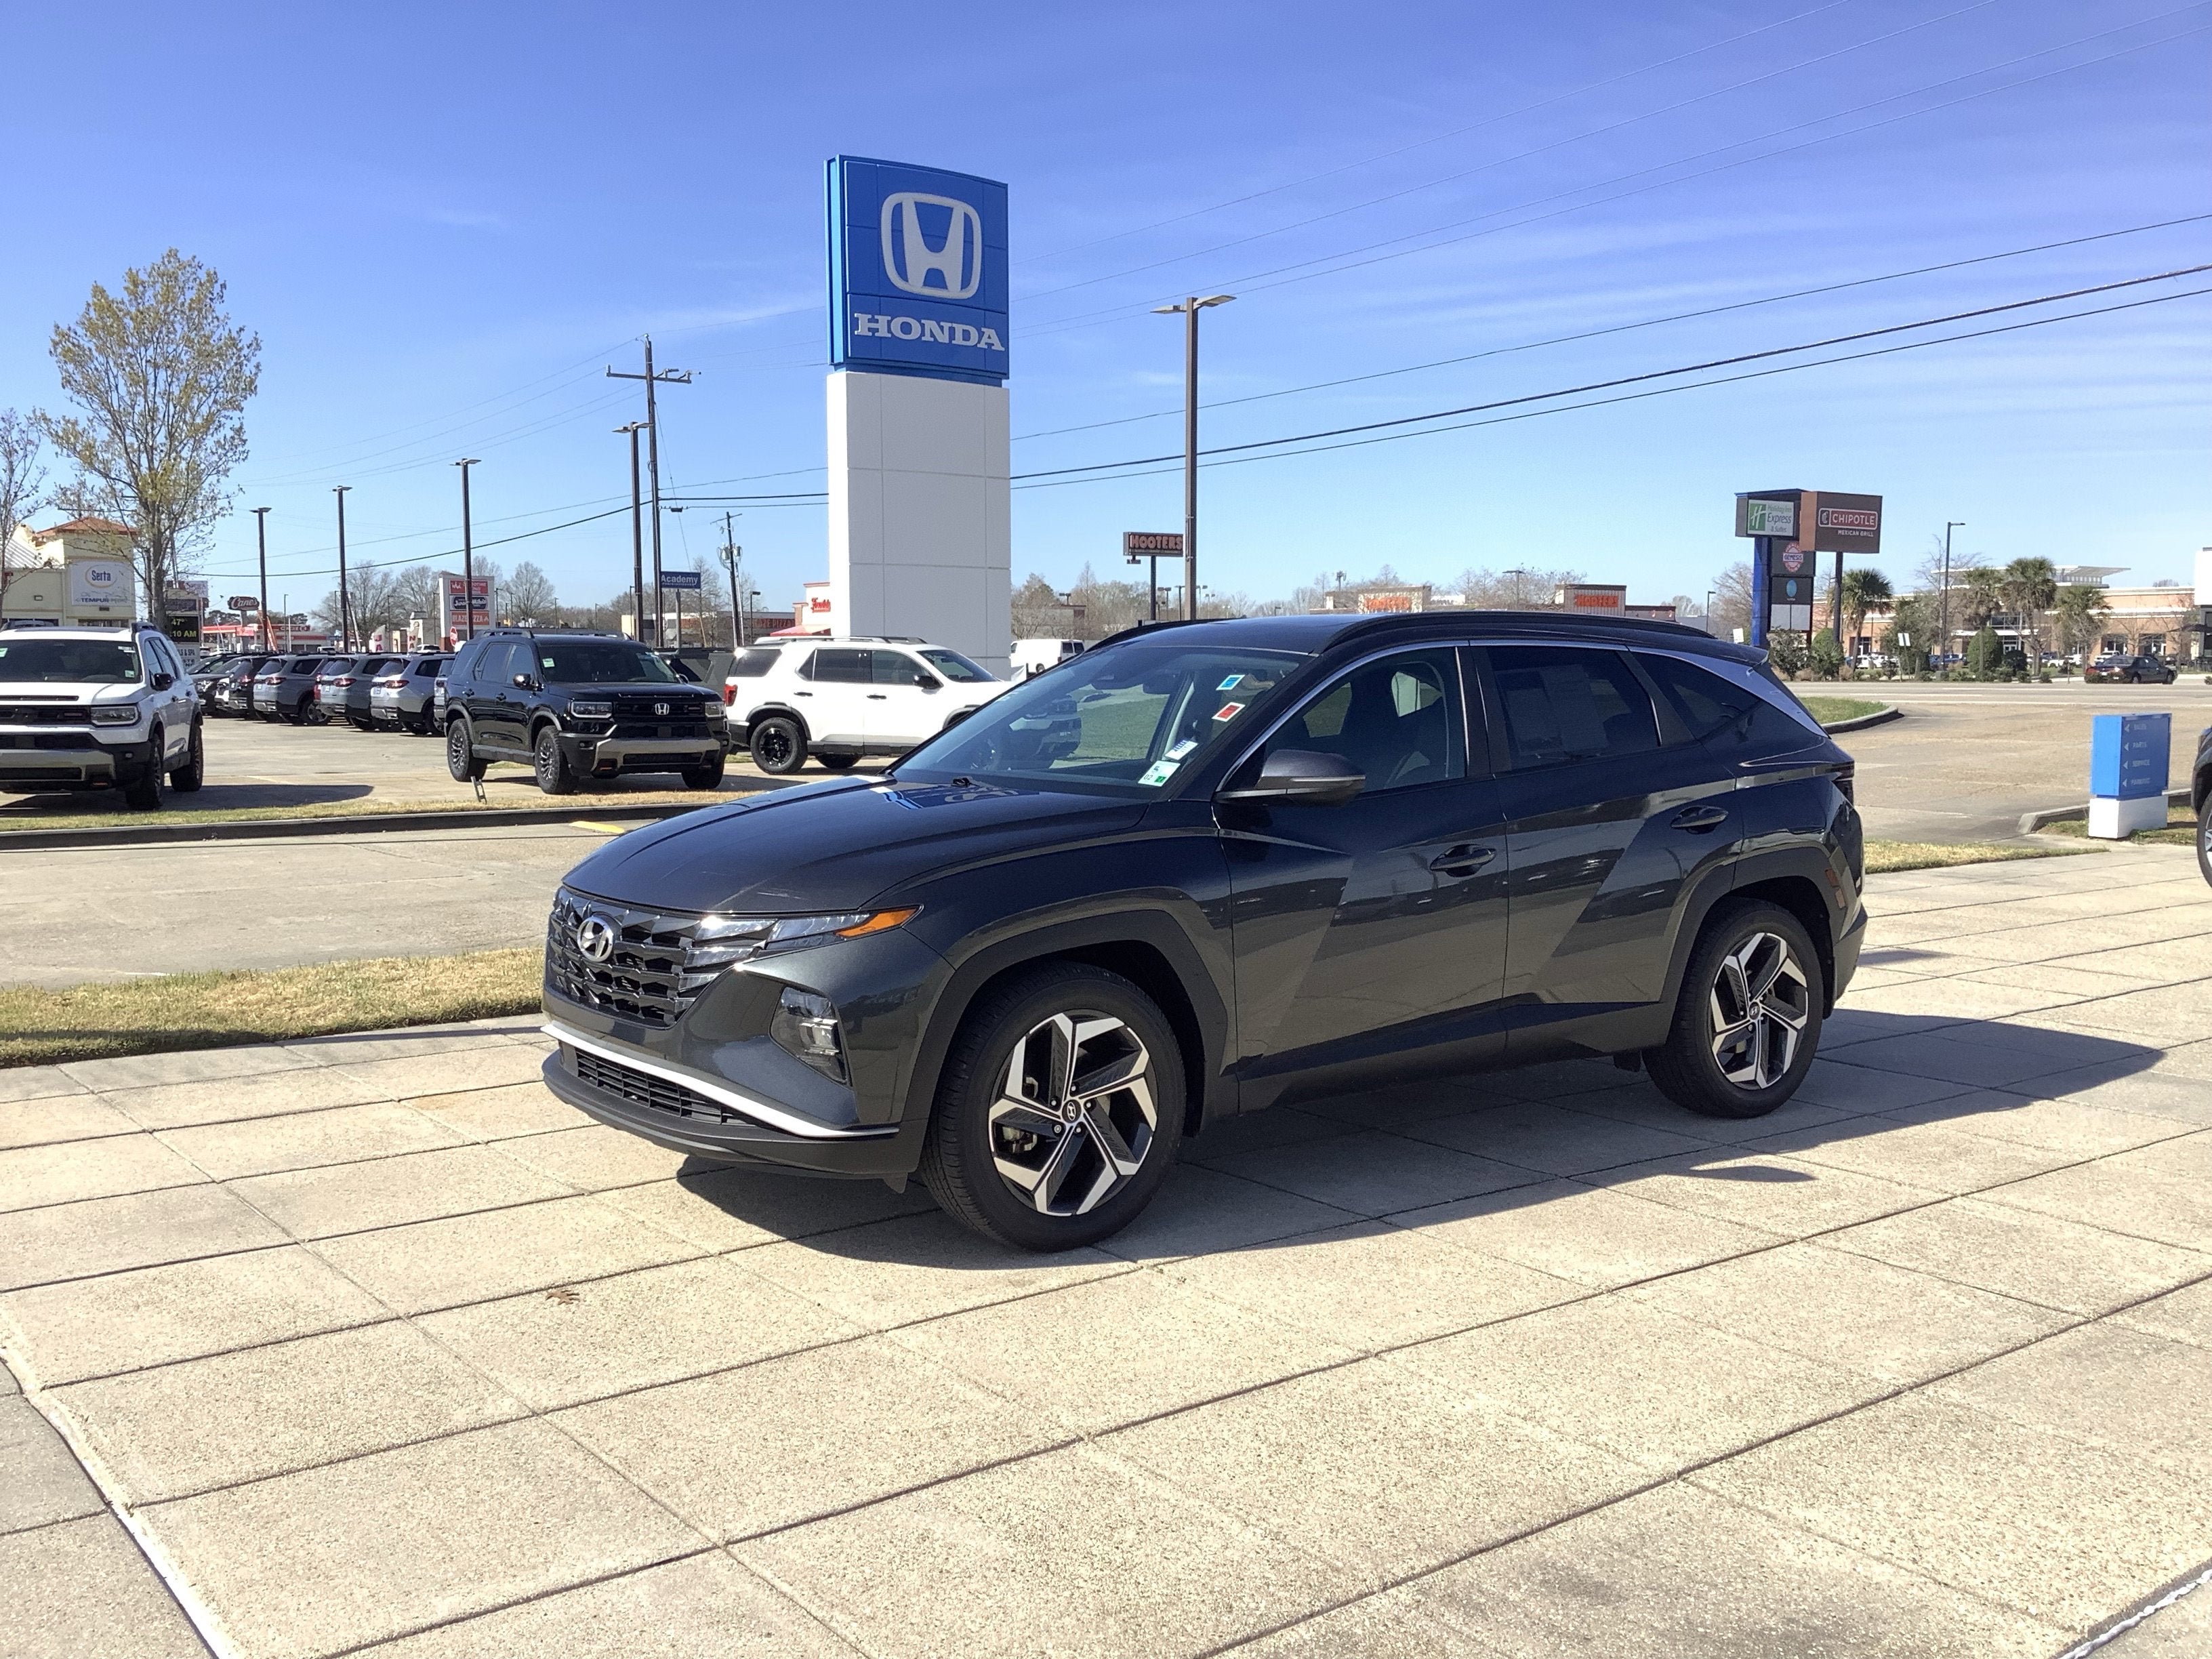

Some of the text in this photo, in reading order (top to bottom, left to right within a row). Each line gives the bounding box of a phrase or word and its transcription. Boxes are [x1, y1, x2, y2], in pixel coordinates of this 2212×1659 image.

[855, 312, 1005, 351] HONDA
[1767, 512, 1792, 525] Express
[1832, 513, 1875, 525] CHIPOTLE
[1130, 534, 1183, 550] HOOTERS
[91, 570, 111, 581] Serta
[661, 575, 699, 586] Academy
[231, 596, 258, 609] Cane's
